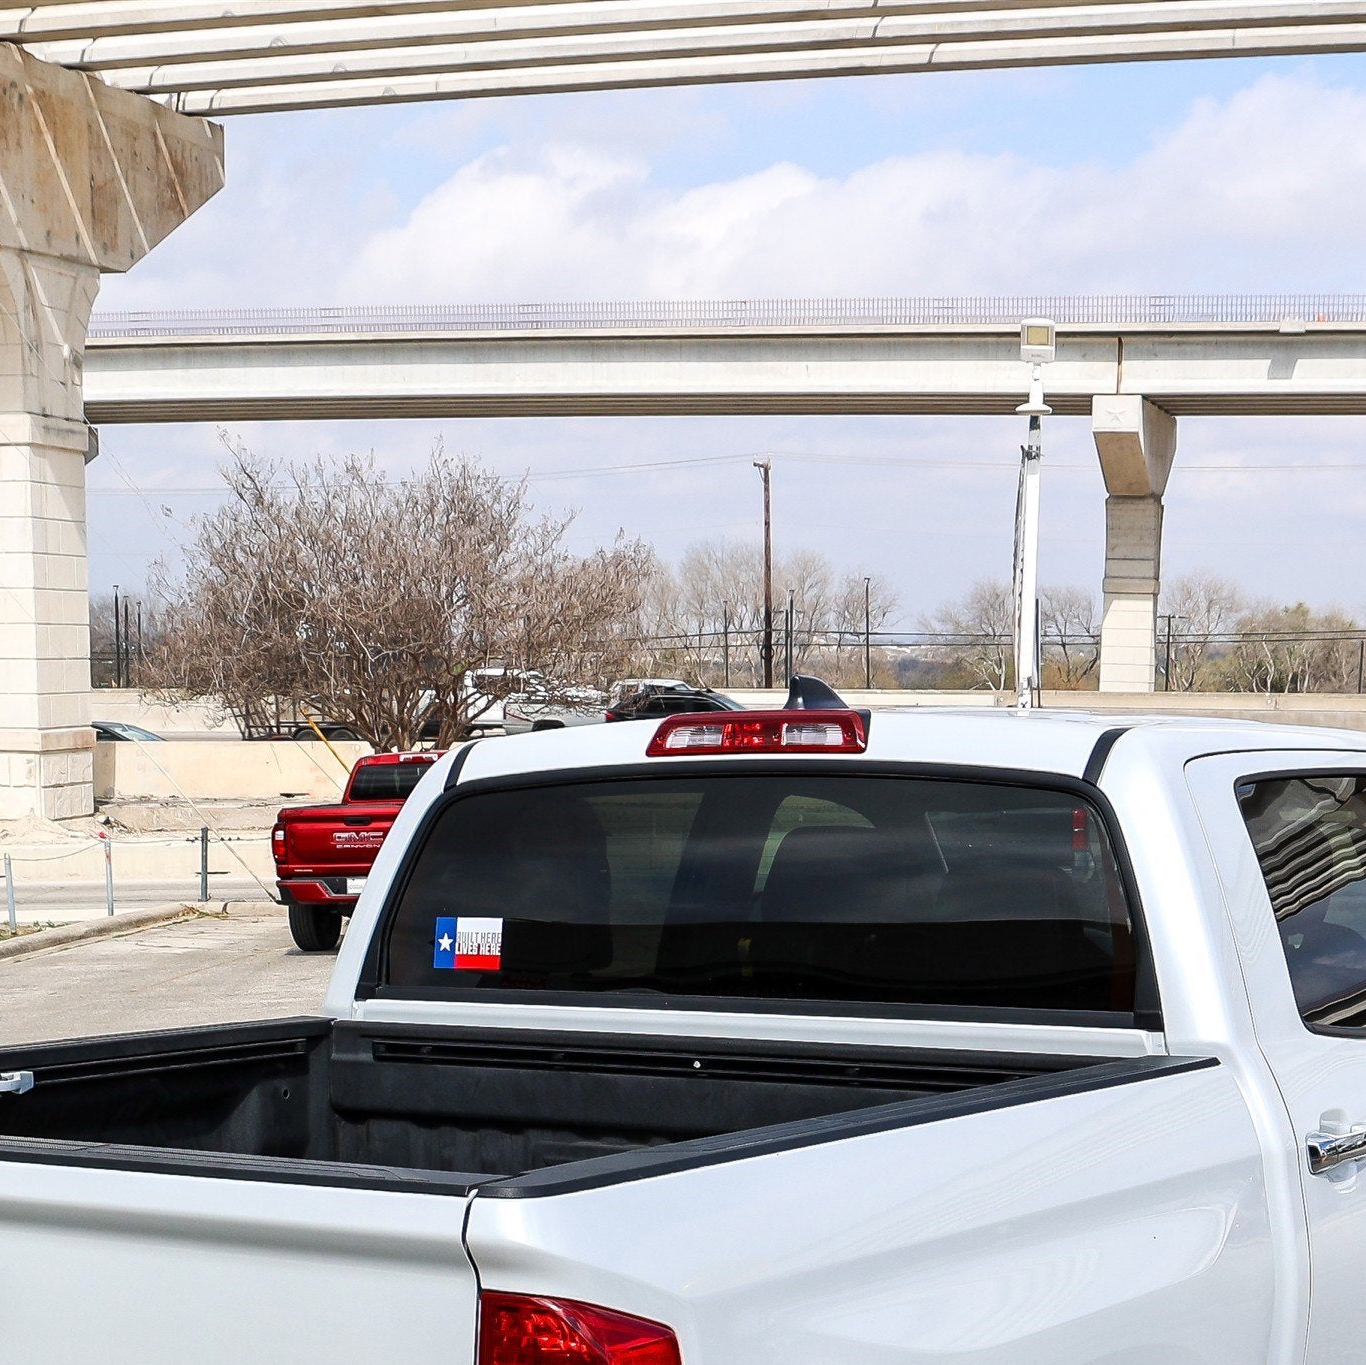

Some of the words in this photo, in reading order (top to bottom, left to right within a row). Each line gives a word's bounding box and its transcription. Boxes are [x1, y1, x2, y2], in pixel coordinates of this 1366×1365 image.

[332, 832, 384, 842] GMC
[480, 931, 502, 944] HERE
[455, 942, 478, 955] LIVES
[479, 943, 501, 956] HERE
